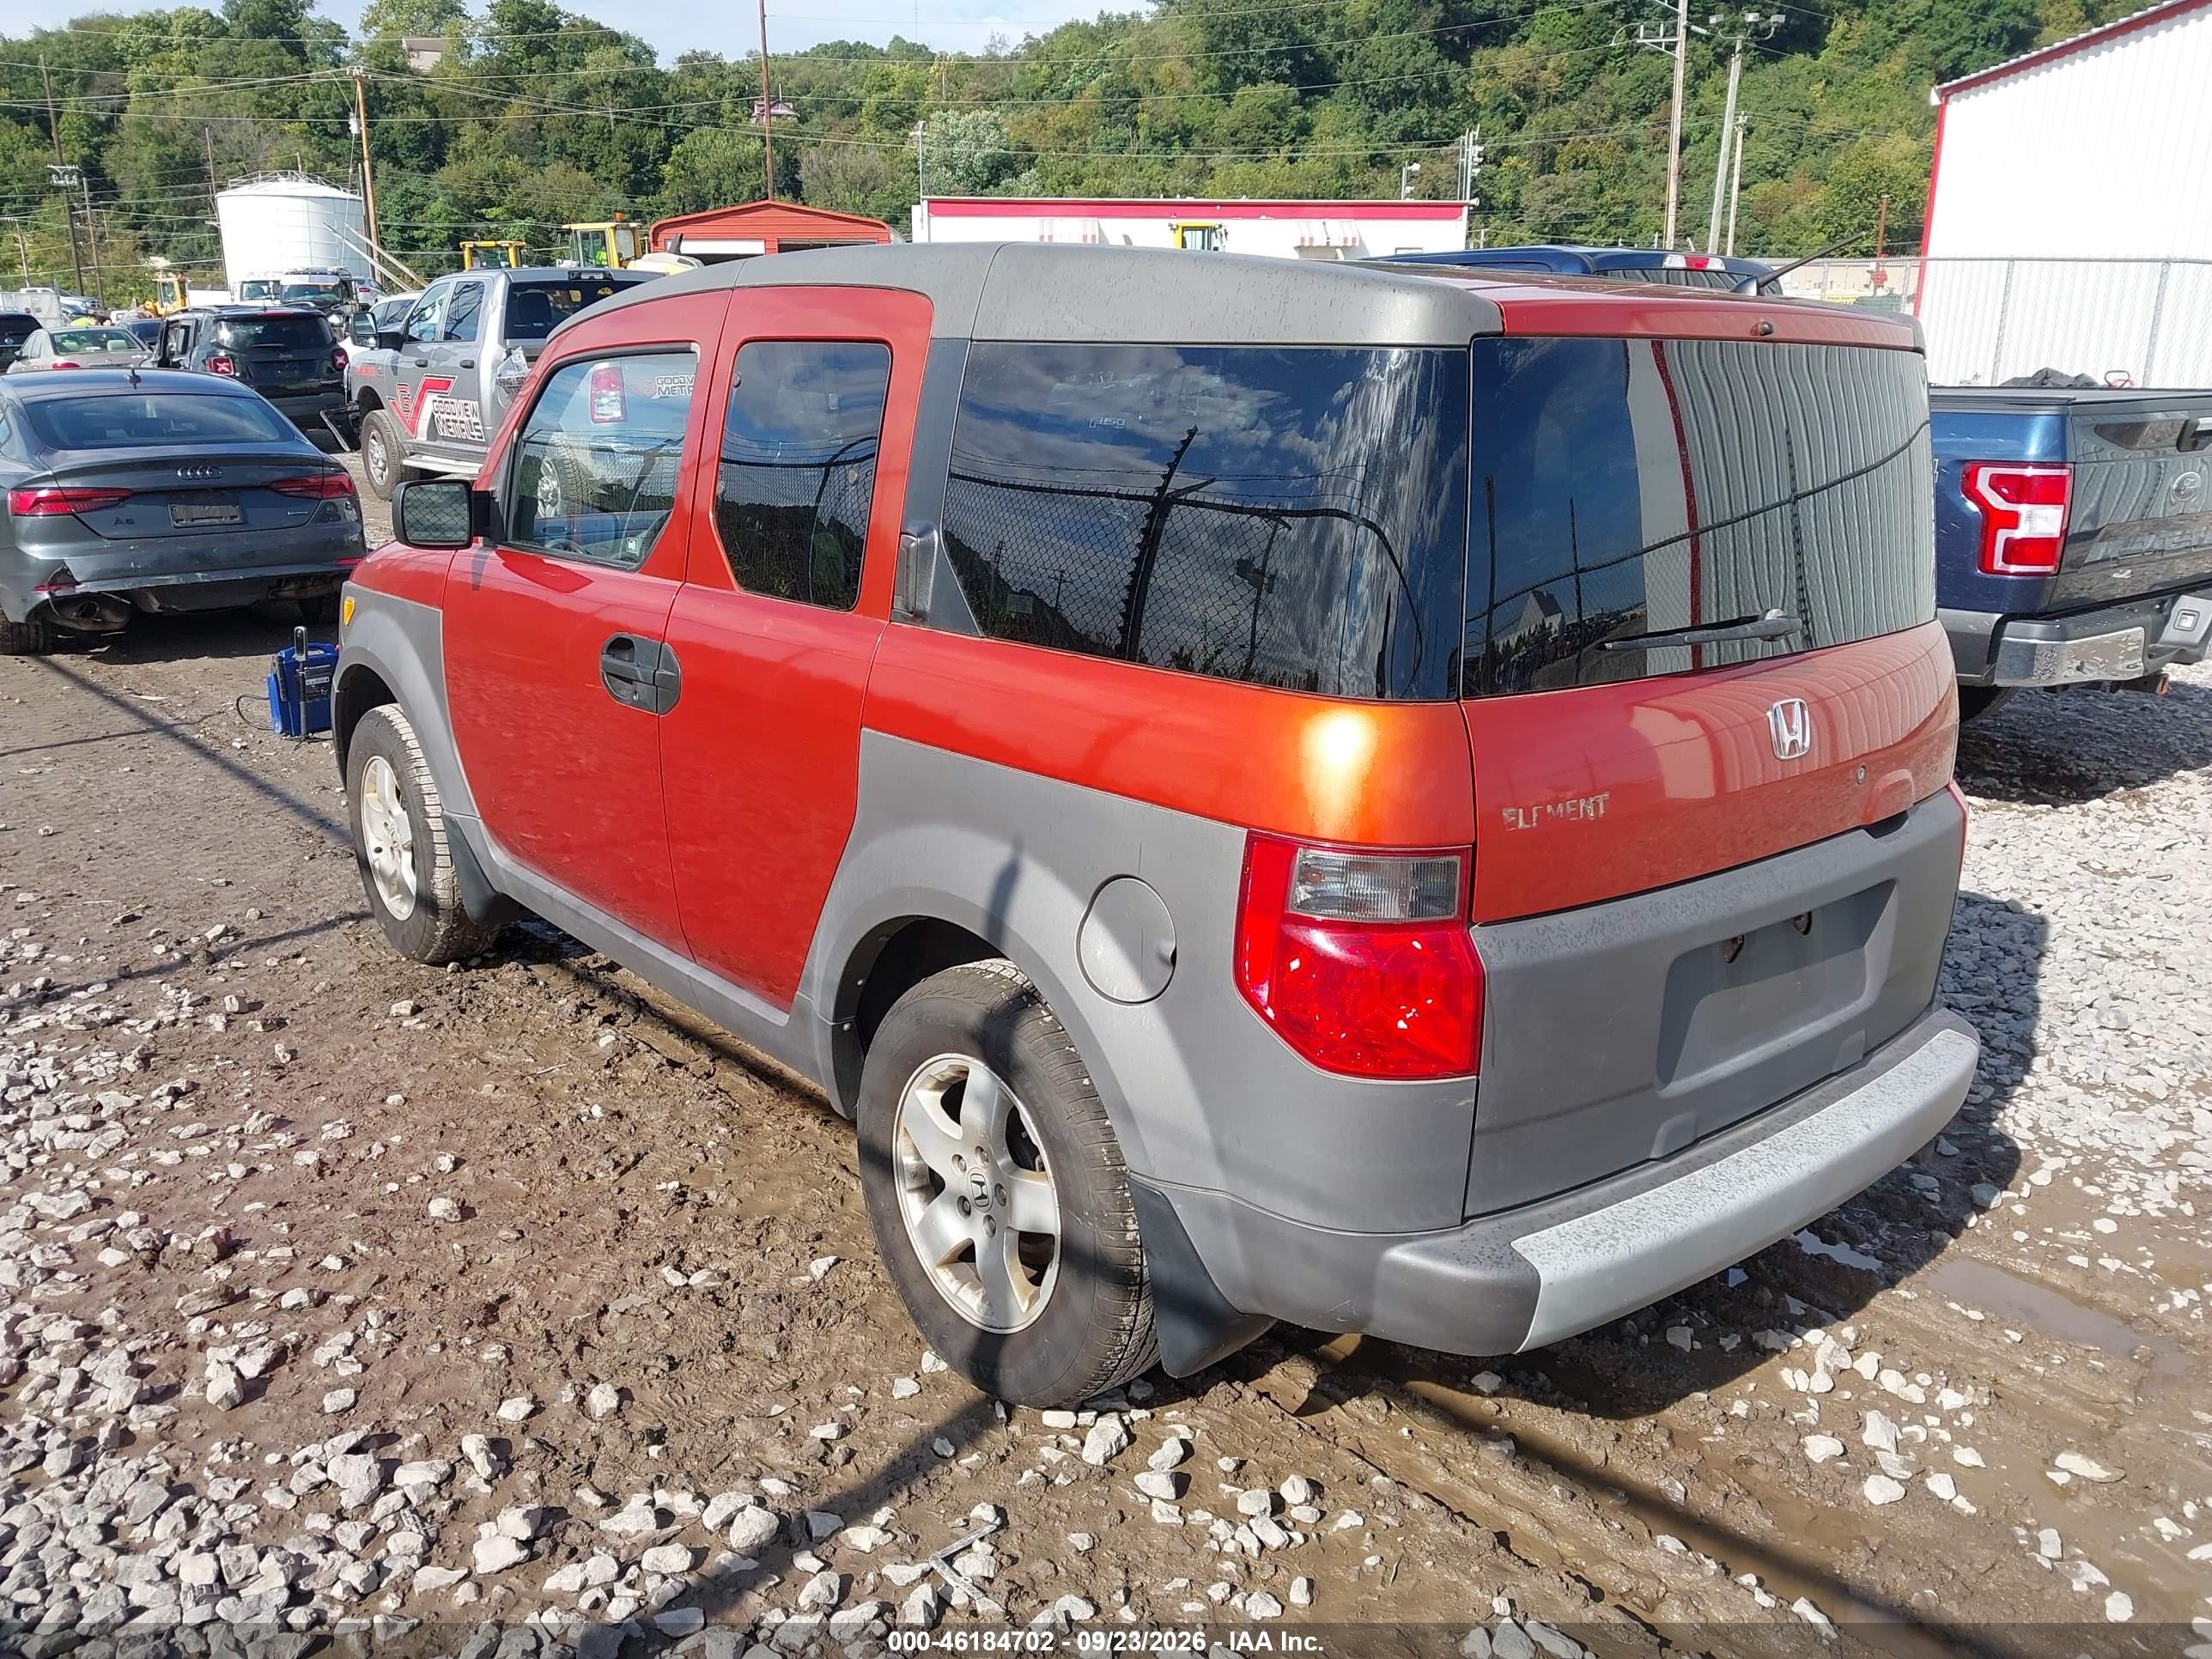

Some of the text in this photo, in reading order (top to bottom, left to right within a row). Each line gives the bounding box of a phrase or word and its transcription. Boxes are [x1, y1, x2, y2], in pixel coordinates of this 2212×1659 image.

[432, 398, 479, 419] GOODVIEW
[434, 416, 484, 441] METALS
[1503, 791, 1610, 831] ELEMENT
